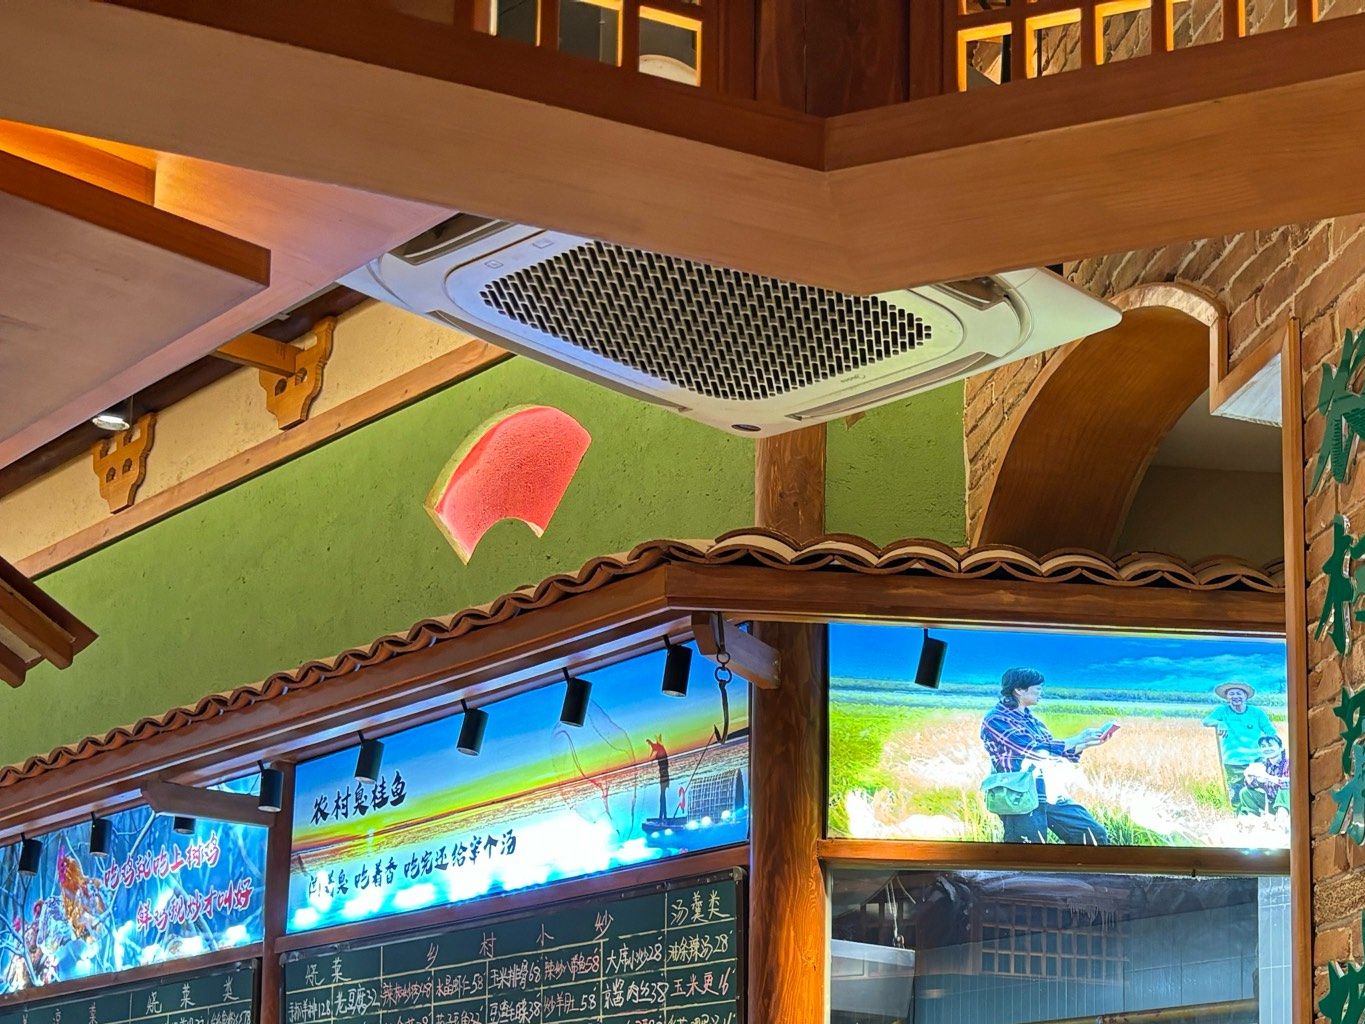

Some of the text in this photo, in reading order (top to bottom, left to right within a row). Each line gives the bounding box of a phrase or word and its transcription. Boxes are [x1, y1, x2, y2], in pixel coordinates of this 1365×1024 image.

[310, 771, 407, 825] 农村臭桂鱼
[103, 830, 220, 889] 吃鸡就吃上树鸡
